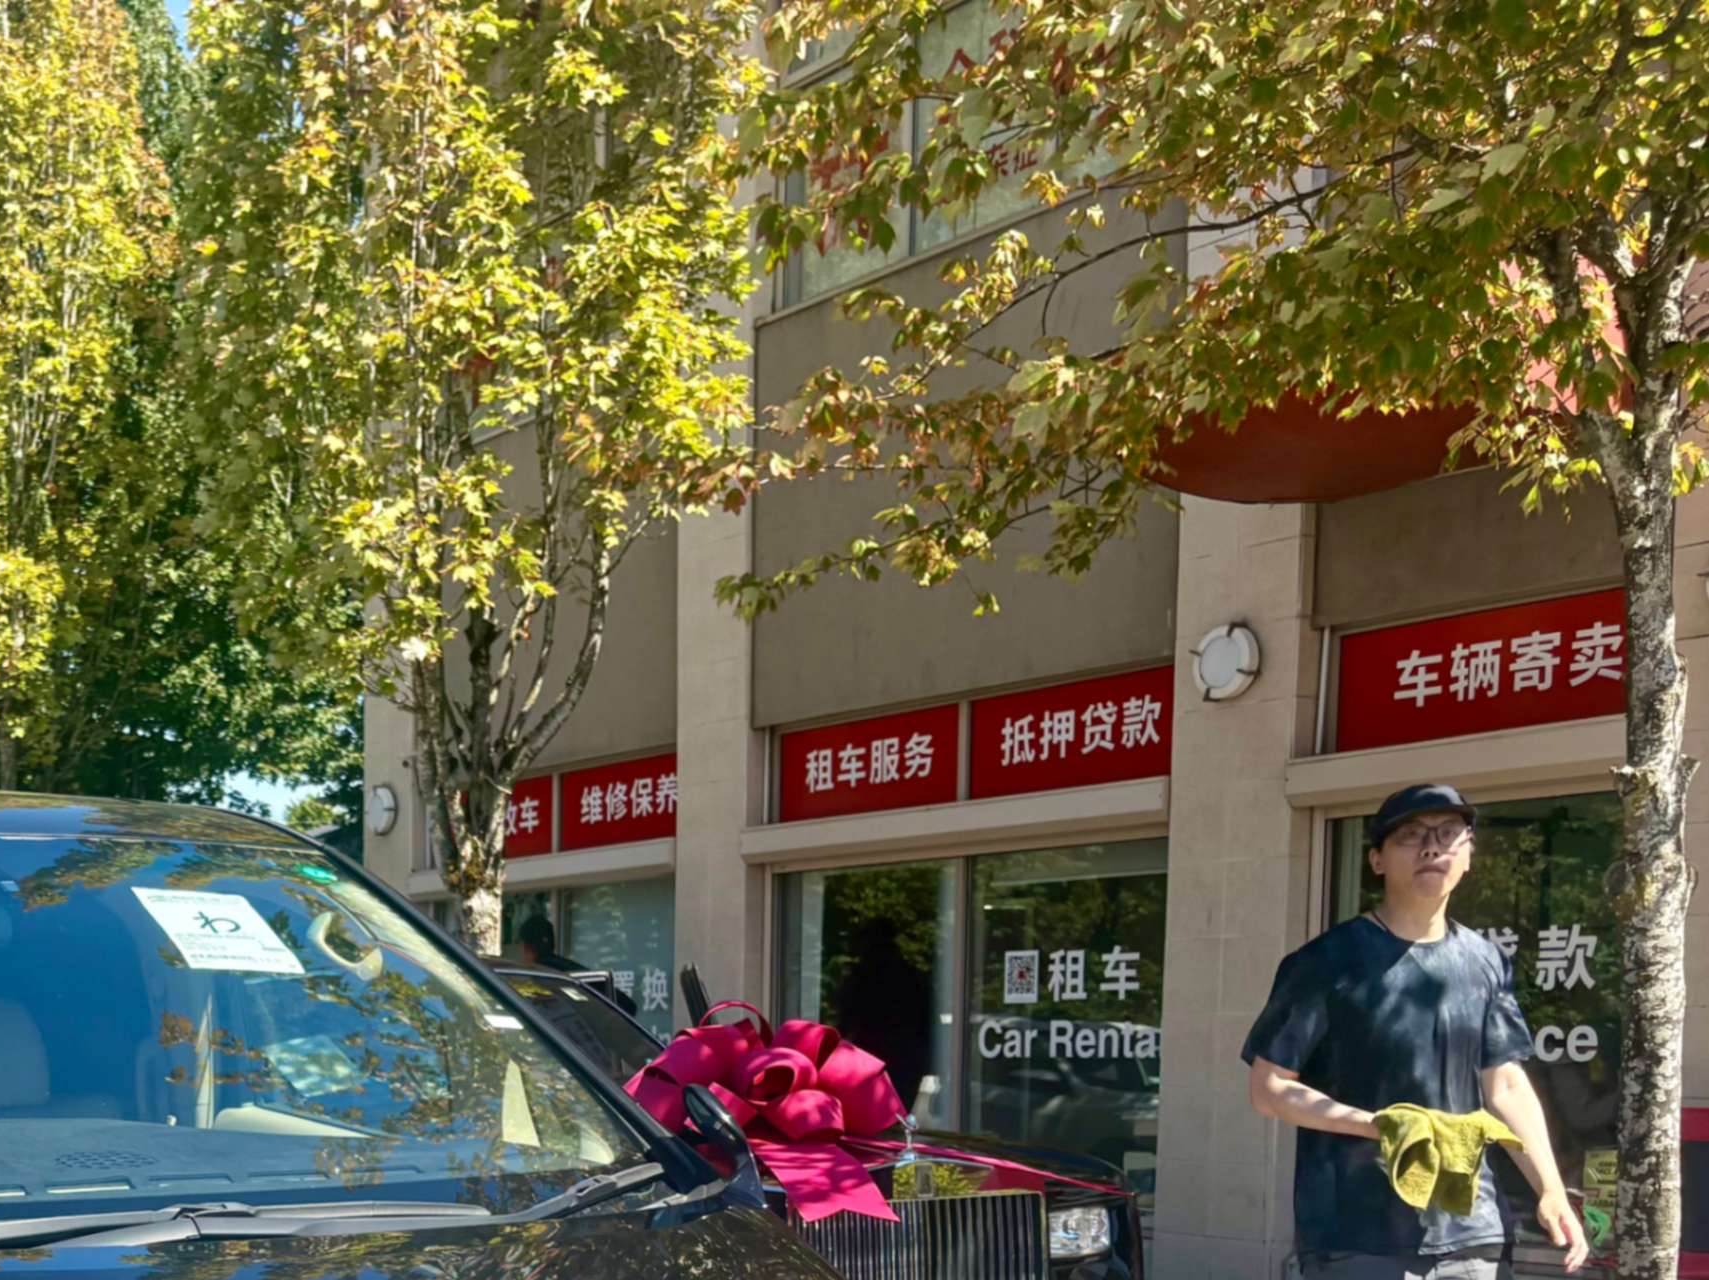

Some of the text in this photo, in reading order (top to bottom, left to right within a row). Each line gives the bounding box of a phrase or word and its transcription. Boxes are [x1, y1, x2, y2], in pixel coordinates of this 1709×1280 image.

[1393, 621, 1624, 708] 车辆寄卖
[1000, 694, 1162, 767] 抵押贷款
[805, 733, 935, 793] 租车服务
[580, 773, 677, 826] 维修保养
[1047, 945, 1141, 1002] 租车
[978, 1019, 1157, 1059] Car Renta
[1534, 1024, 1599, 1063] ce
